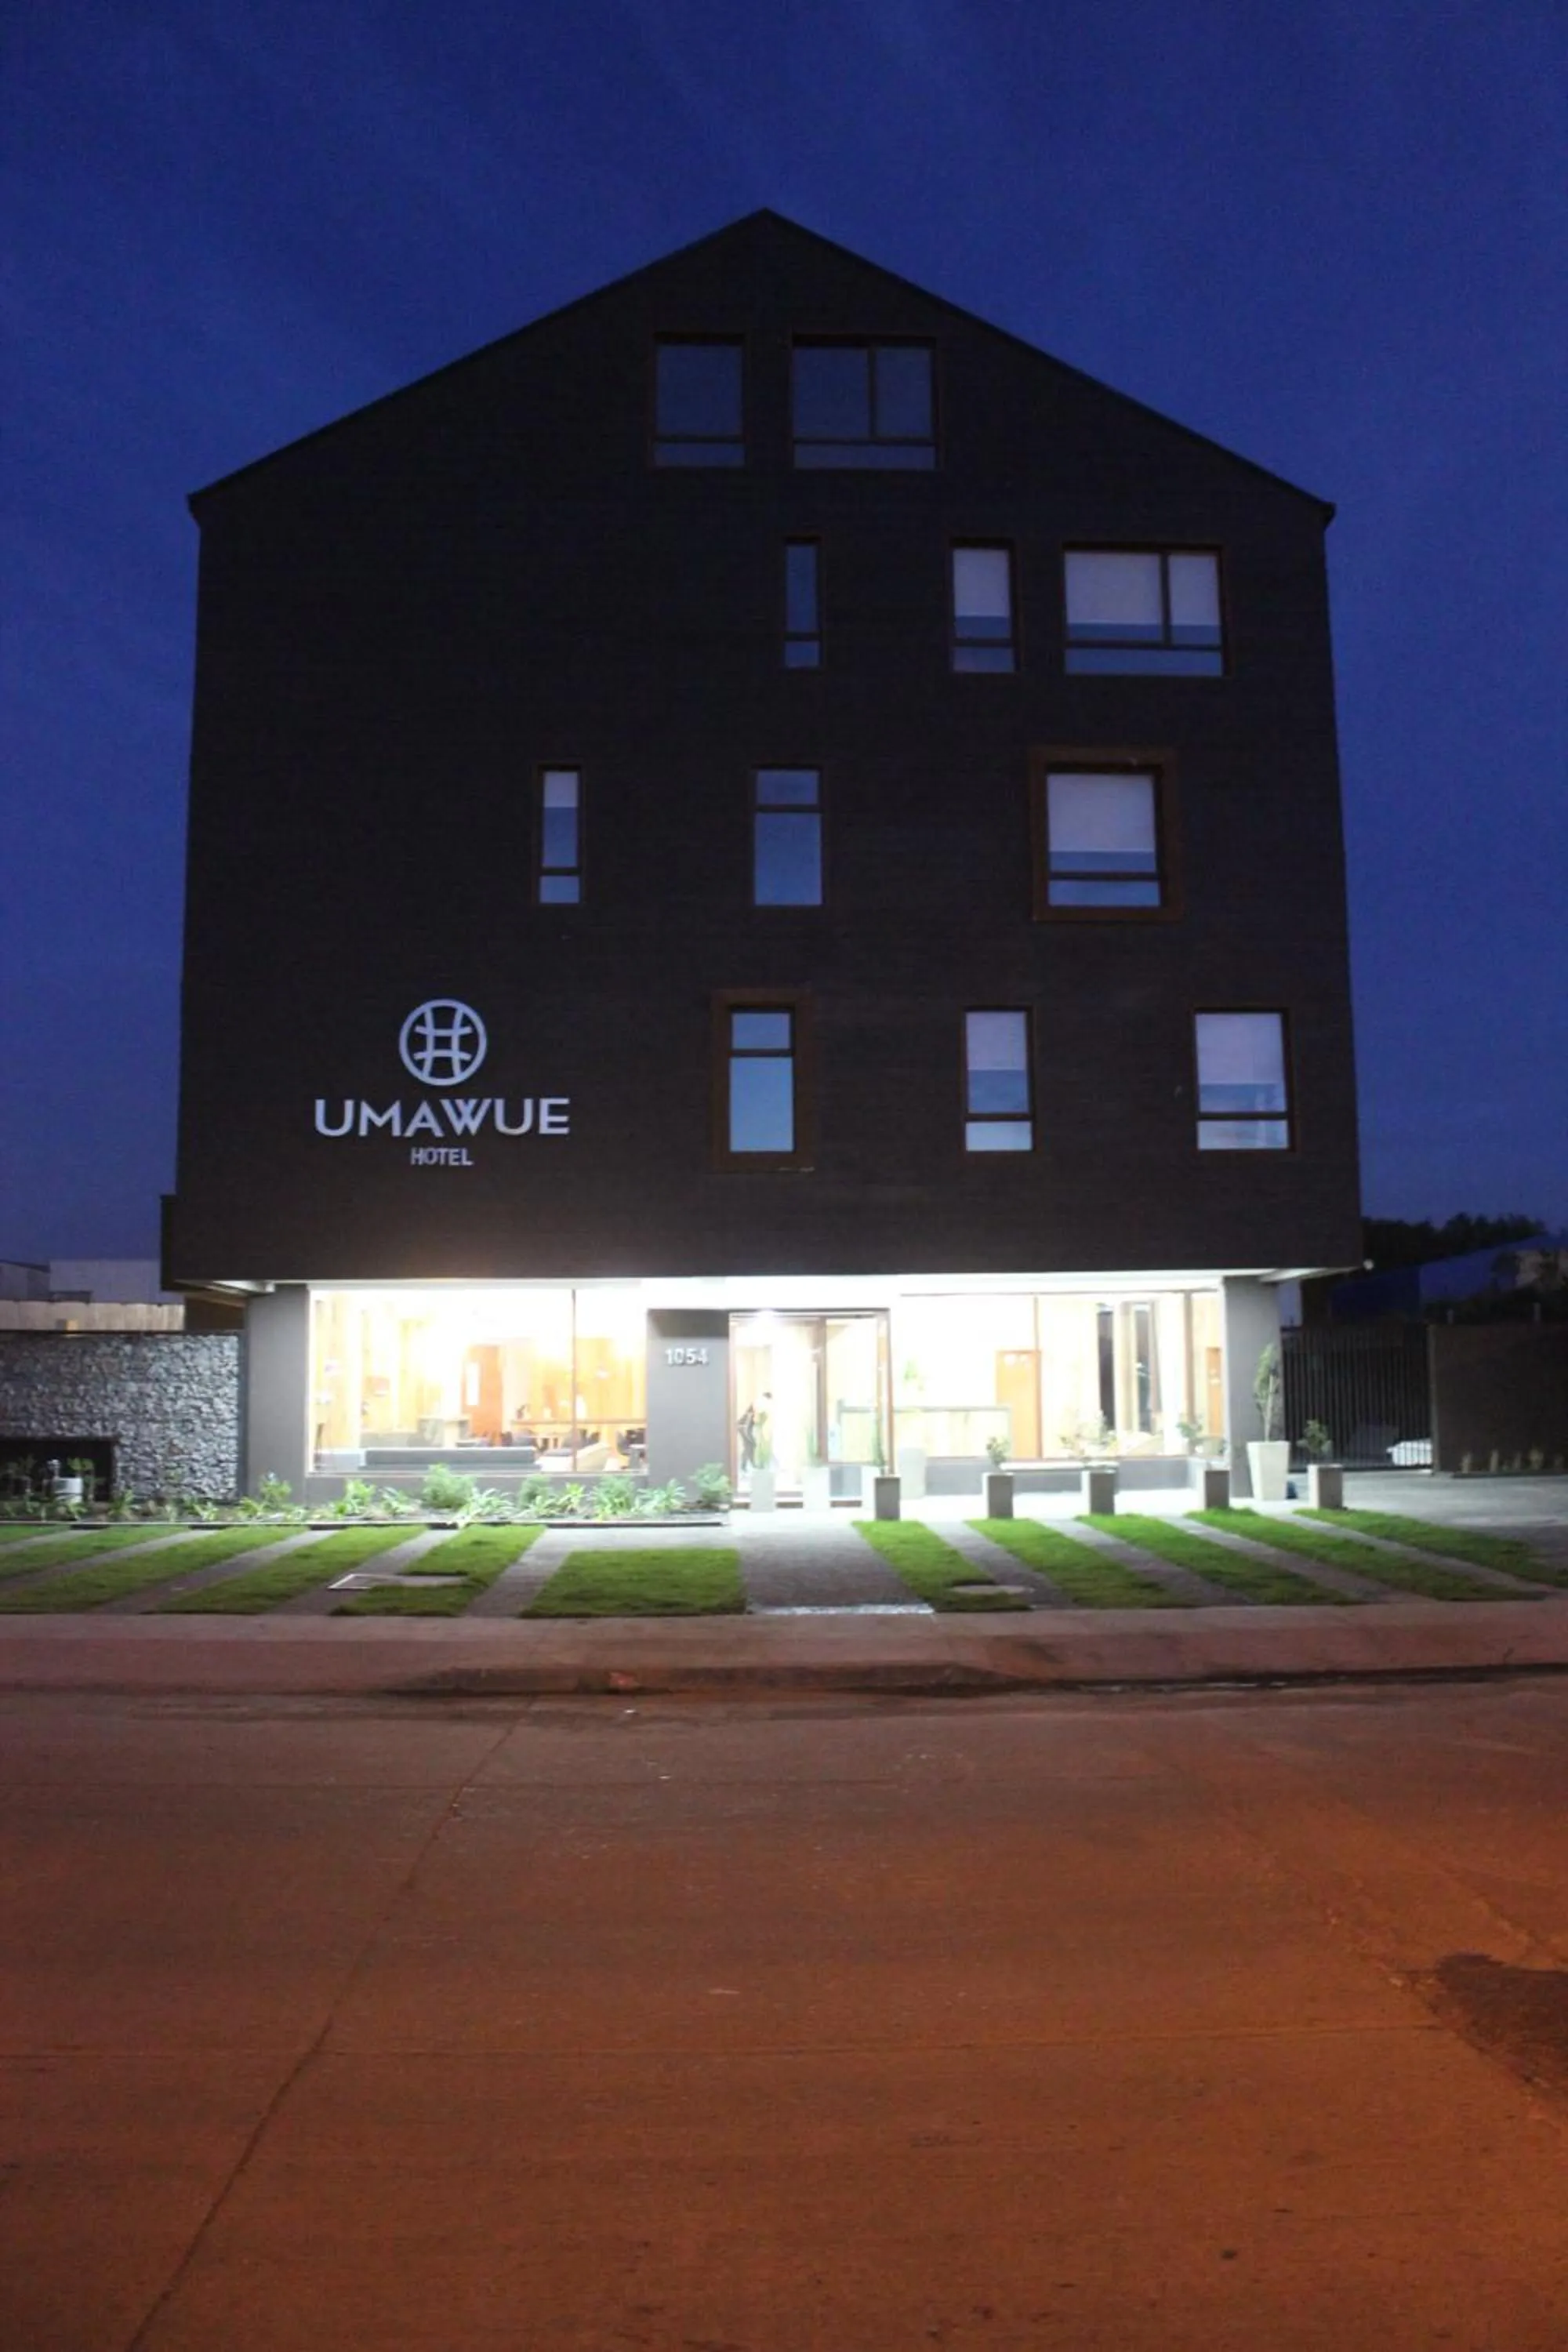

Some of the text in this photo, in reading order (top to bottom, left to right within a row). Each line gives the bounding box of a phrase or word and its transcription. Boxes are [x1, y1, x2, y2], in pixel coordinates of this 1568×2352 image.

[315, 1098, 570, 1137] UMAWUE
[410, 1148, 474, 1166] HOTEL
[665, 1347, 709, 1366] 1054
